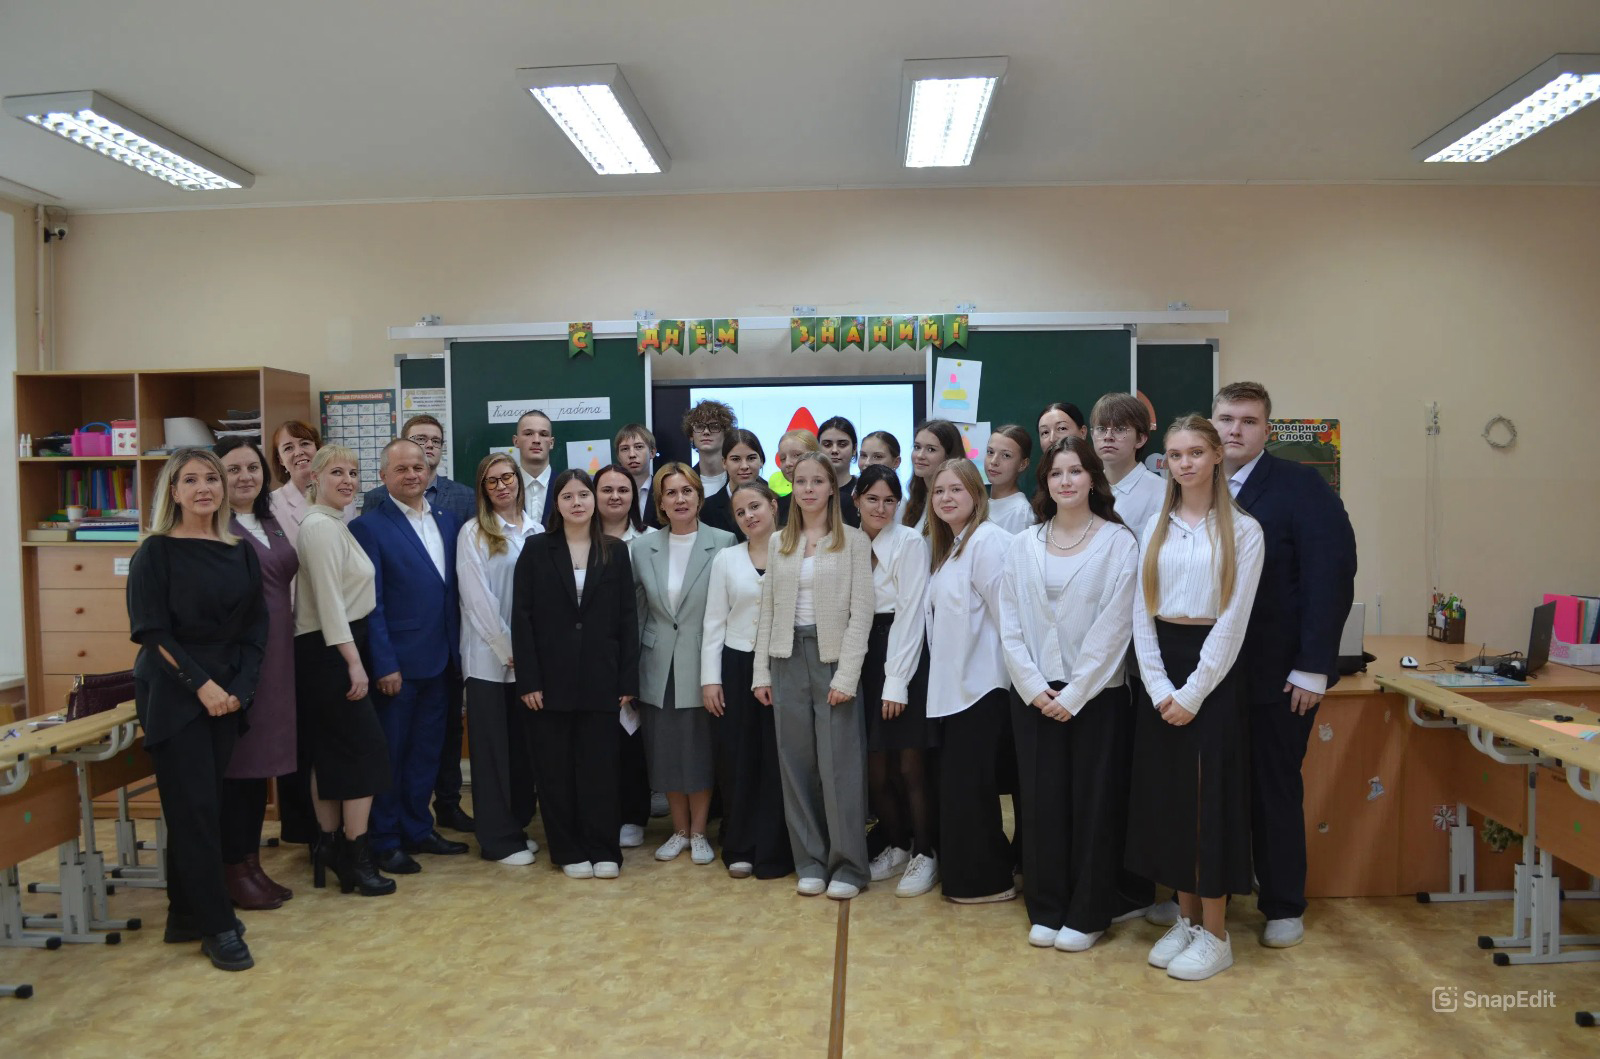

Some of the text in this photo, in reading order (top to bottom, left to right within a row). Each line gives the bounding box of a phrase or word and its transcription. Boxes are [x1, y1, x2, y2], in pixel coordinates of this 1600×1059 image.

[572, 322, 960, 348] С ДНЁМ ЗНАНИЙ!
[557, 401, 602, 420] работа
[1269, 422, 1328, 433] ловарные
[1279, 432, 1313, 441] слова
